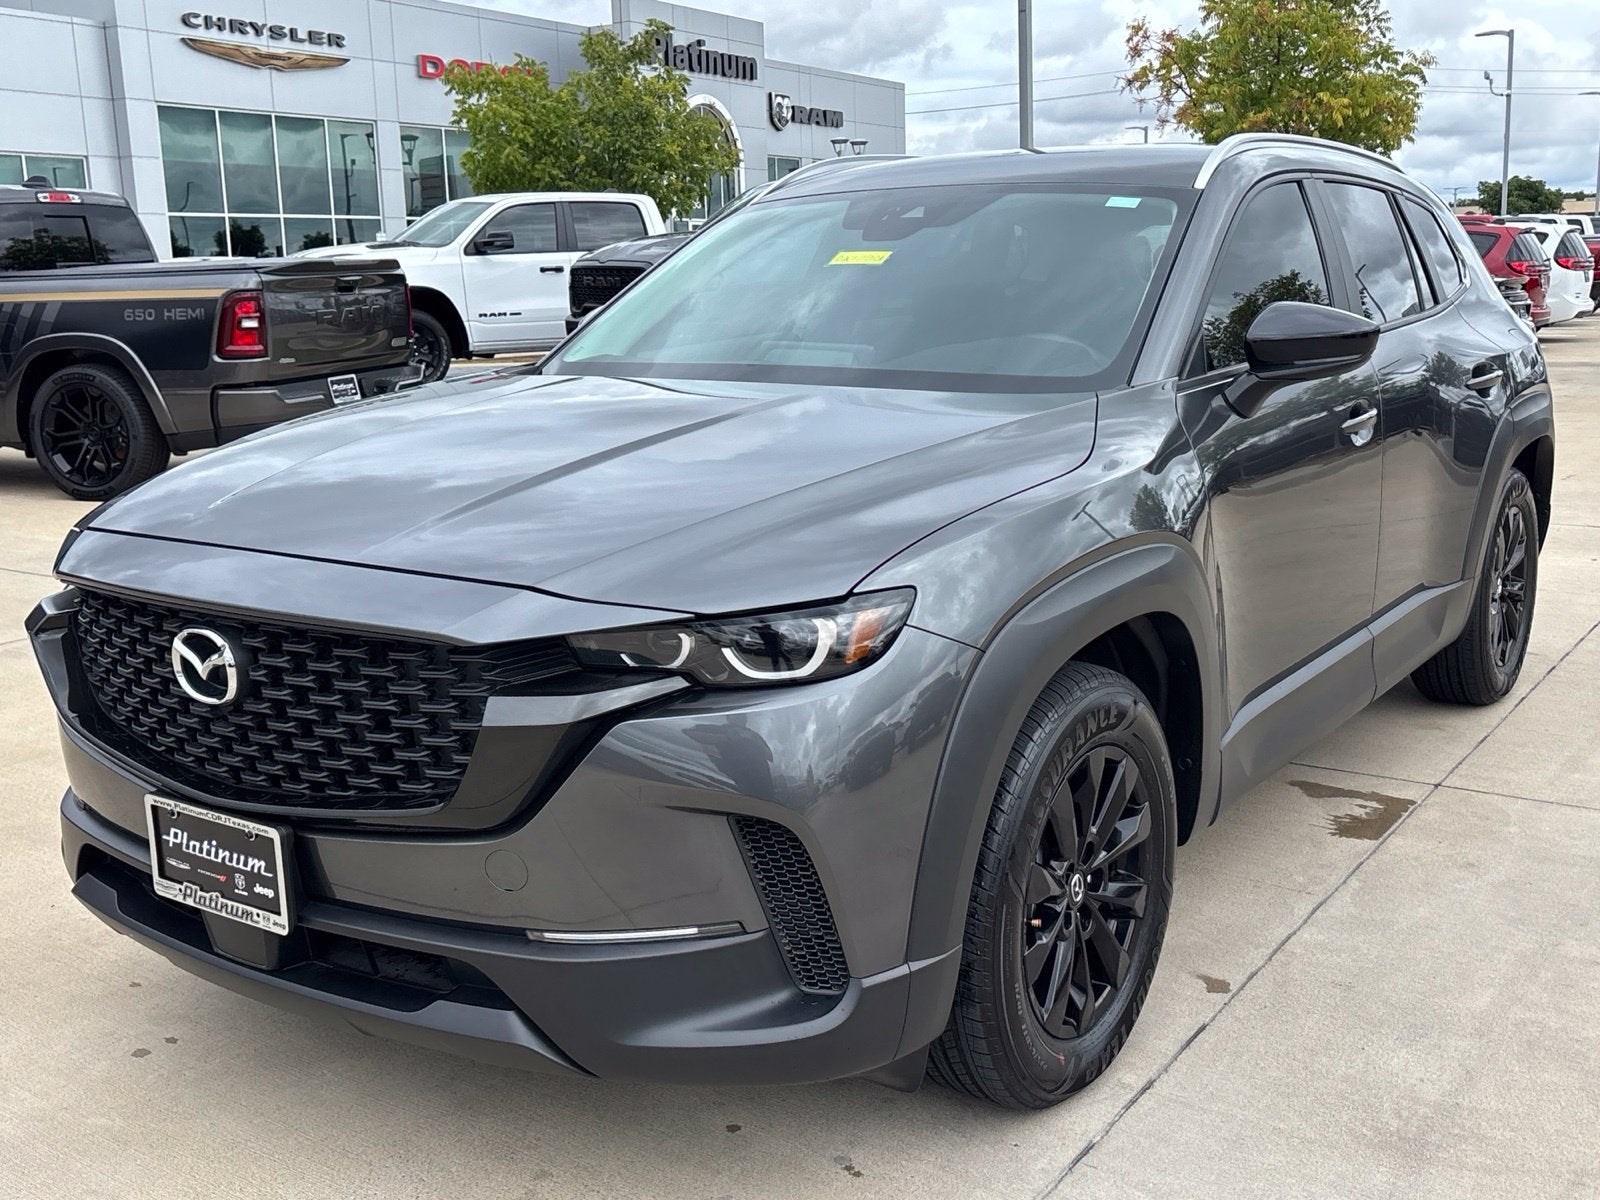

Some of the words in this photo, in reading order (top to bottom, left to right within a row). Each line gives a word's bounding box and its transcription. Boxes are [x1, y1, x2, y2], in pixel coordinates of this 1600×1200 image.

[181, 12, 346, 48] CHRYSLER
[650, 33, 758, 80] Platinum
[792, 105, 843, 127] RAM
[583, 276, 622, 288] RAM
[123, 308, 156, 321] 650
[163, 307, 206, 320] HEMI
[1026, 700, 1122, 842] ASSURANCE
[162, 827, 273, 878] Platinum
[175, 883, 260, 925] Platinum
[253, 882, 275, 899] Jeep
